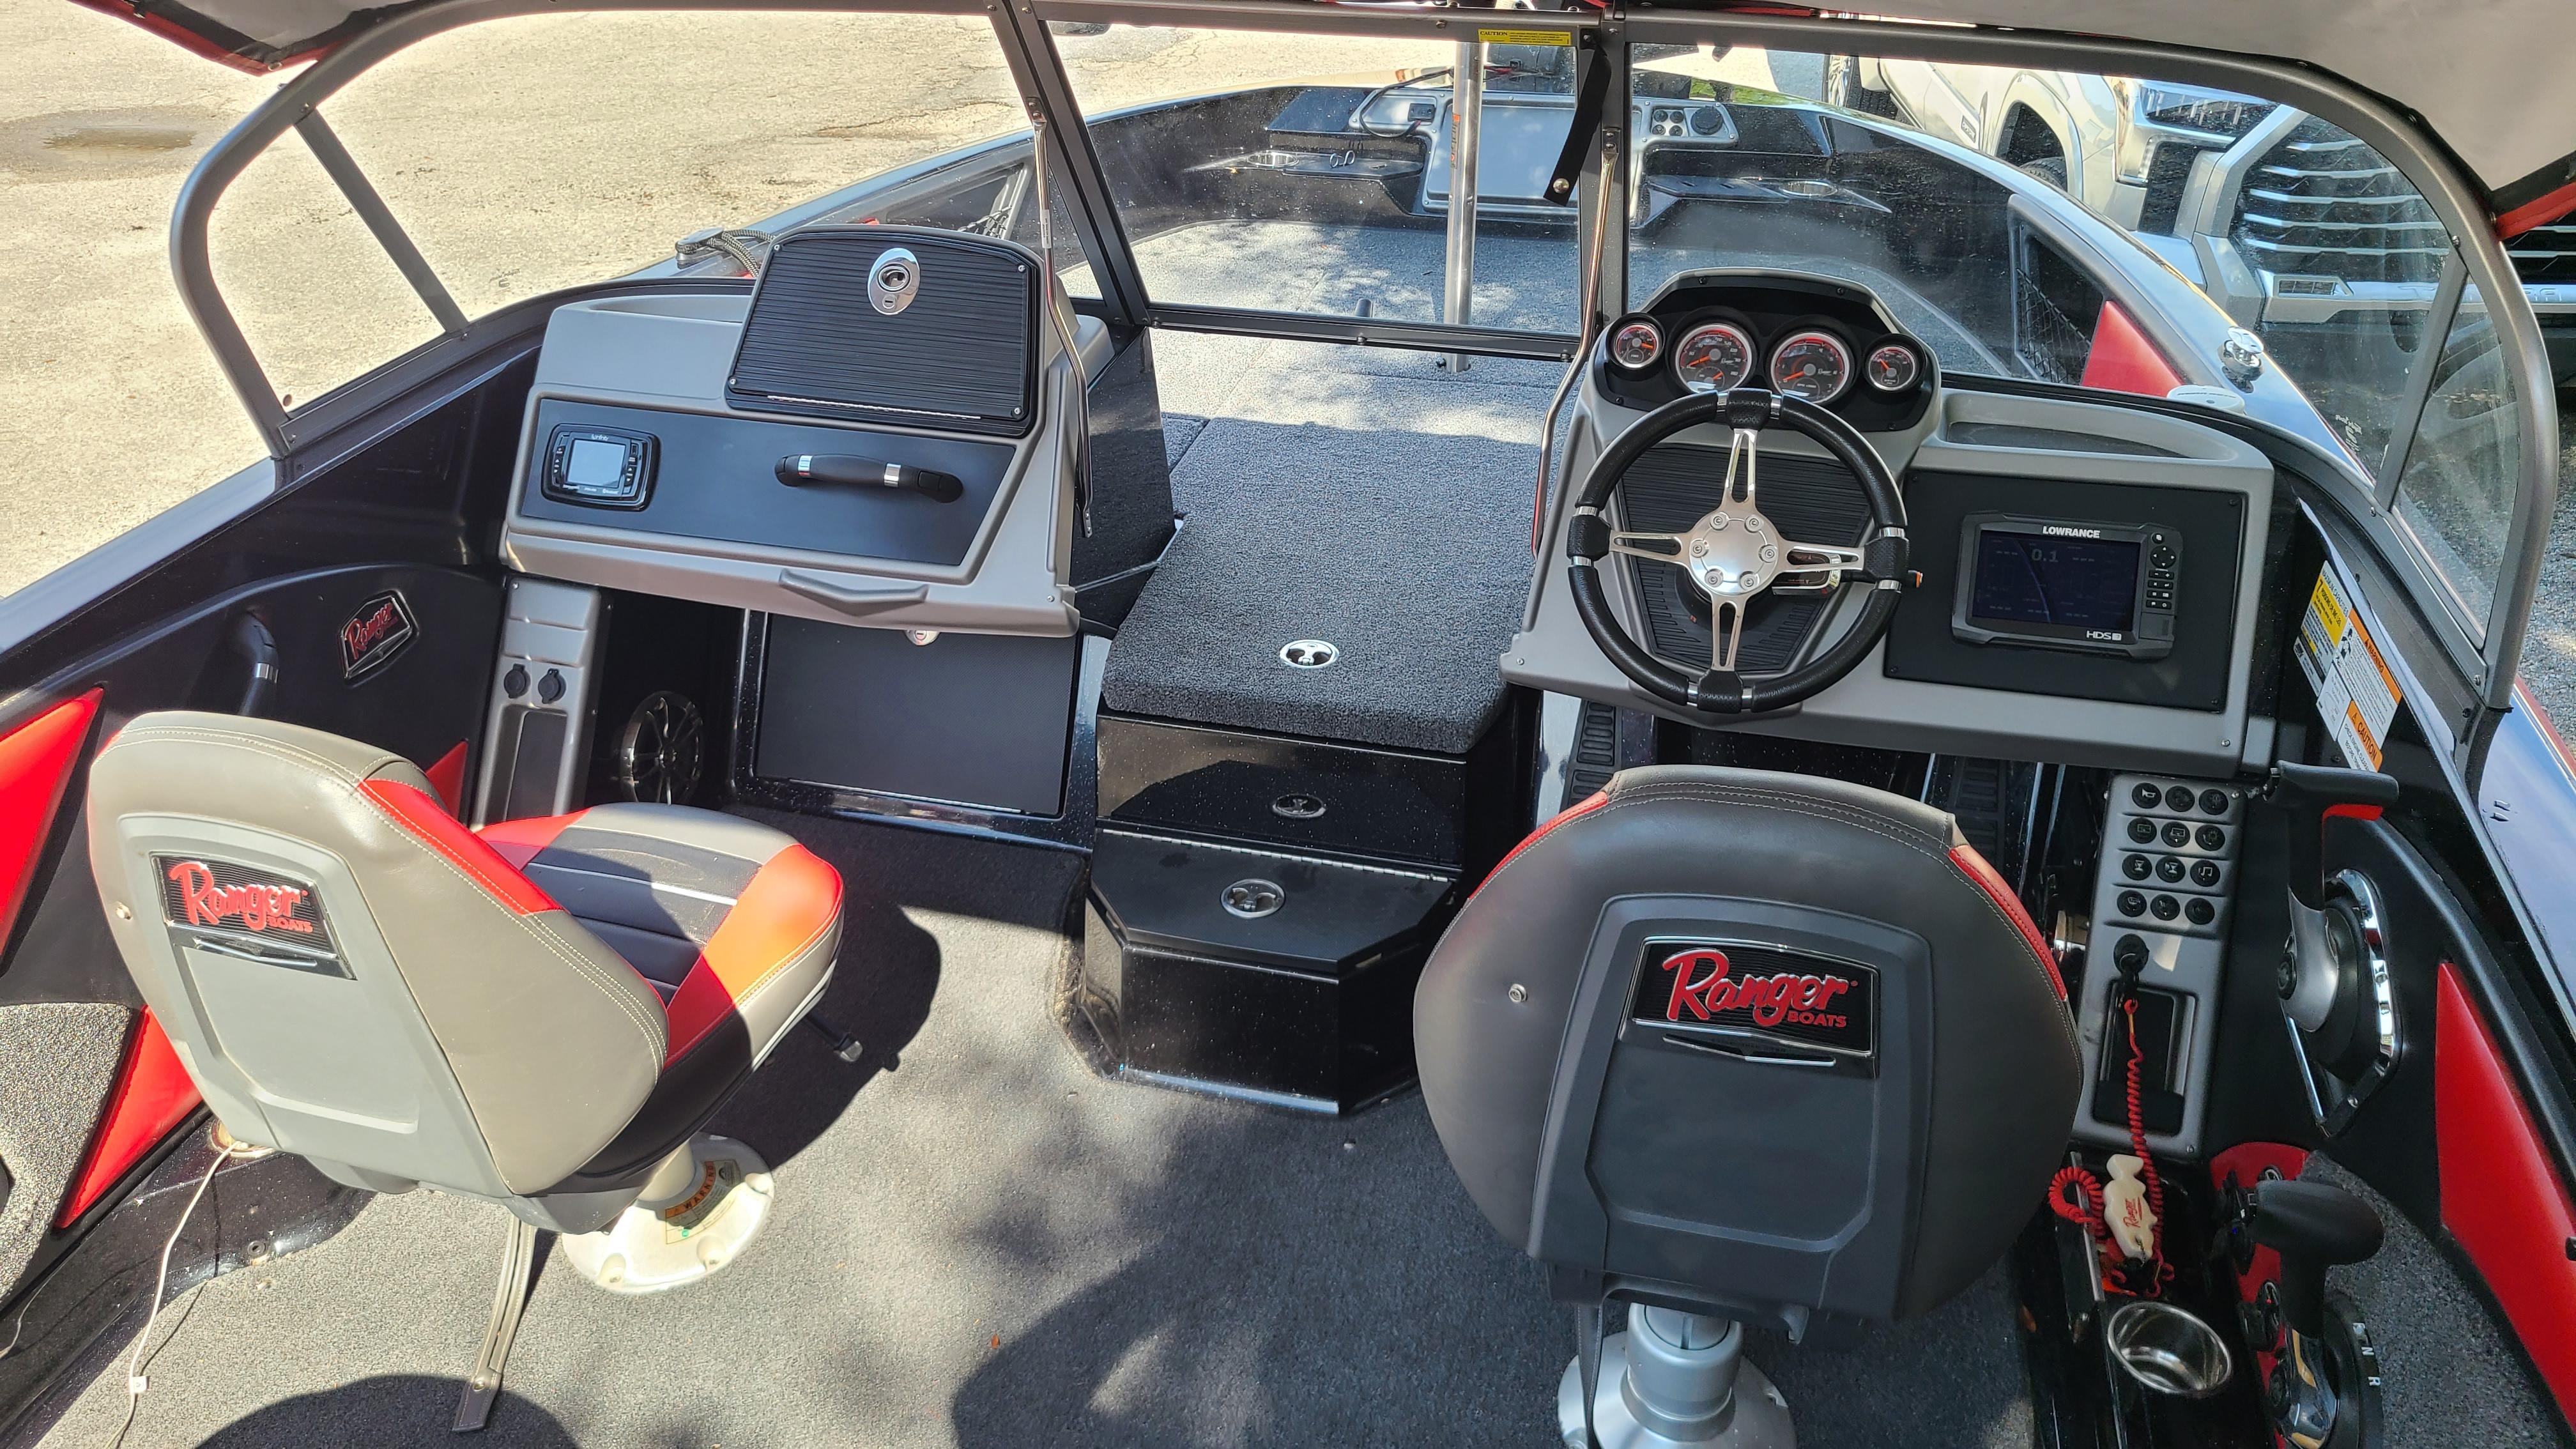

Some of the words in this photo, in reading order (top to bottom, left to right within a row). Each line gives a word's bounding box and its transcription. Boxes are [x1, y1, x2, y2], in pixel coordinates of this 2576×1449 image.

[2043, 526, 2101, 539] LOWRANCE
[2032, 548, 2058, 563] 0.1
[344, 602, 394, 660] Ranger
[2086, 630, 2112, 640] HDS
[2368, 643, 2384, 673] WARNING
[2358, 721, 2377, 761] CAUTION
[168, 861, 302, 931] Ranger
[266, 916, 314, 933] BOATS
[1662, 948, 1850, 1027] Ranger
[1786, 1010, 1847, 1028] BOATS
[684, 1163, 714, 1209] WARNING
[2361, 1346, 2375, 1356] N
